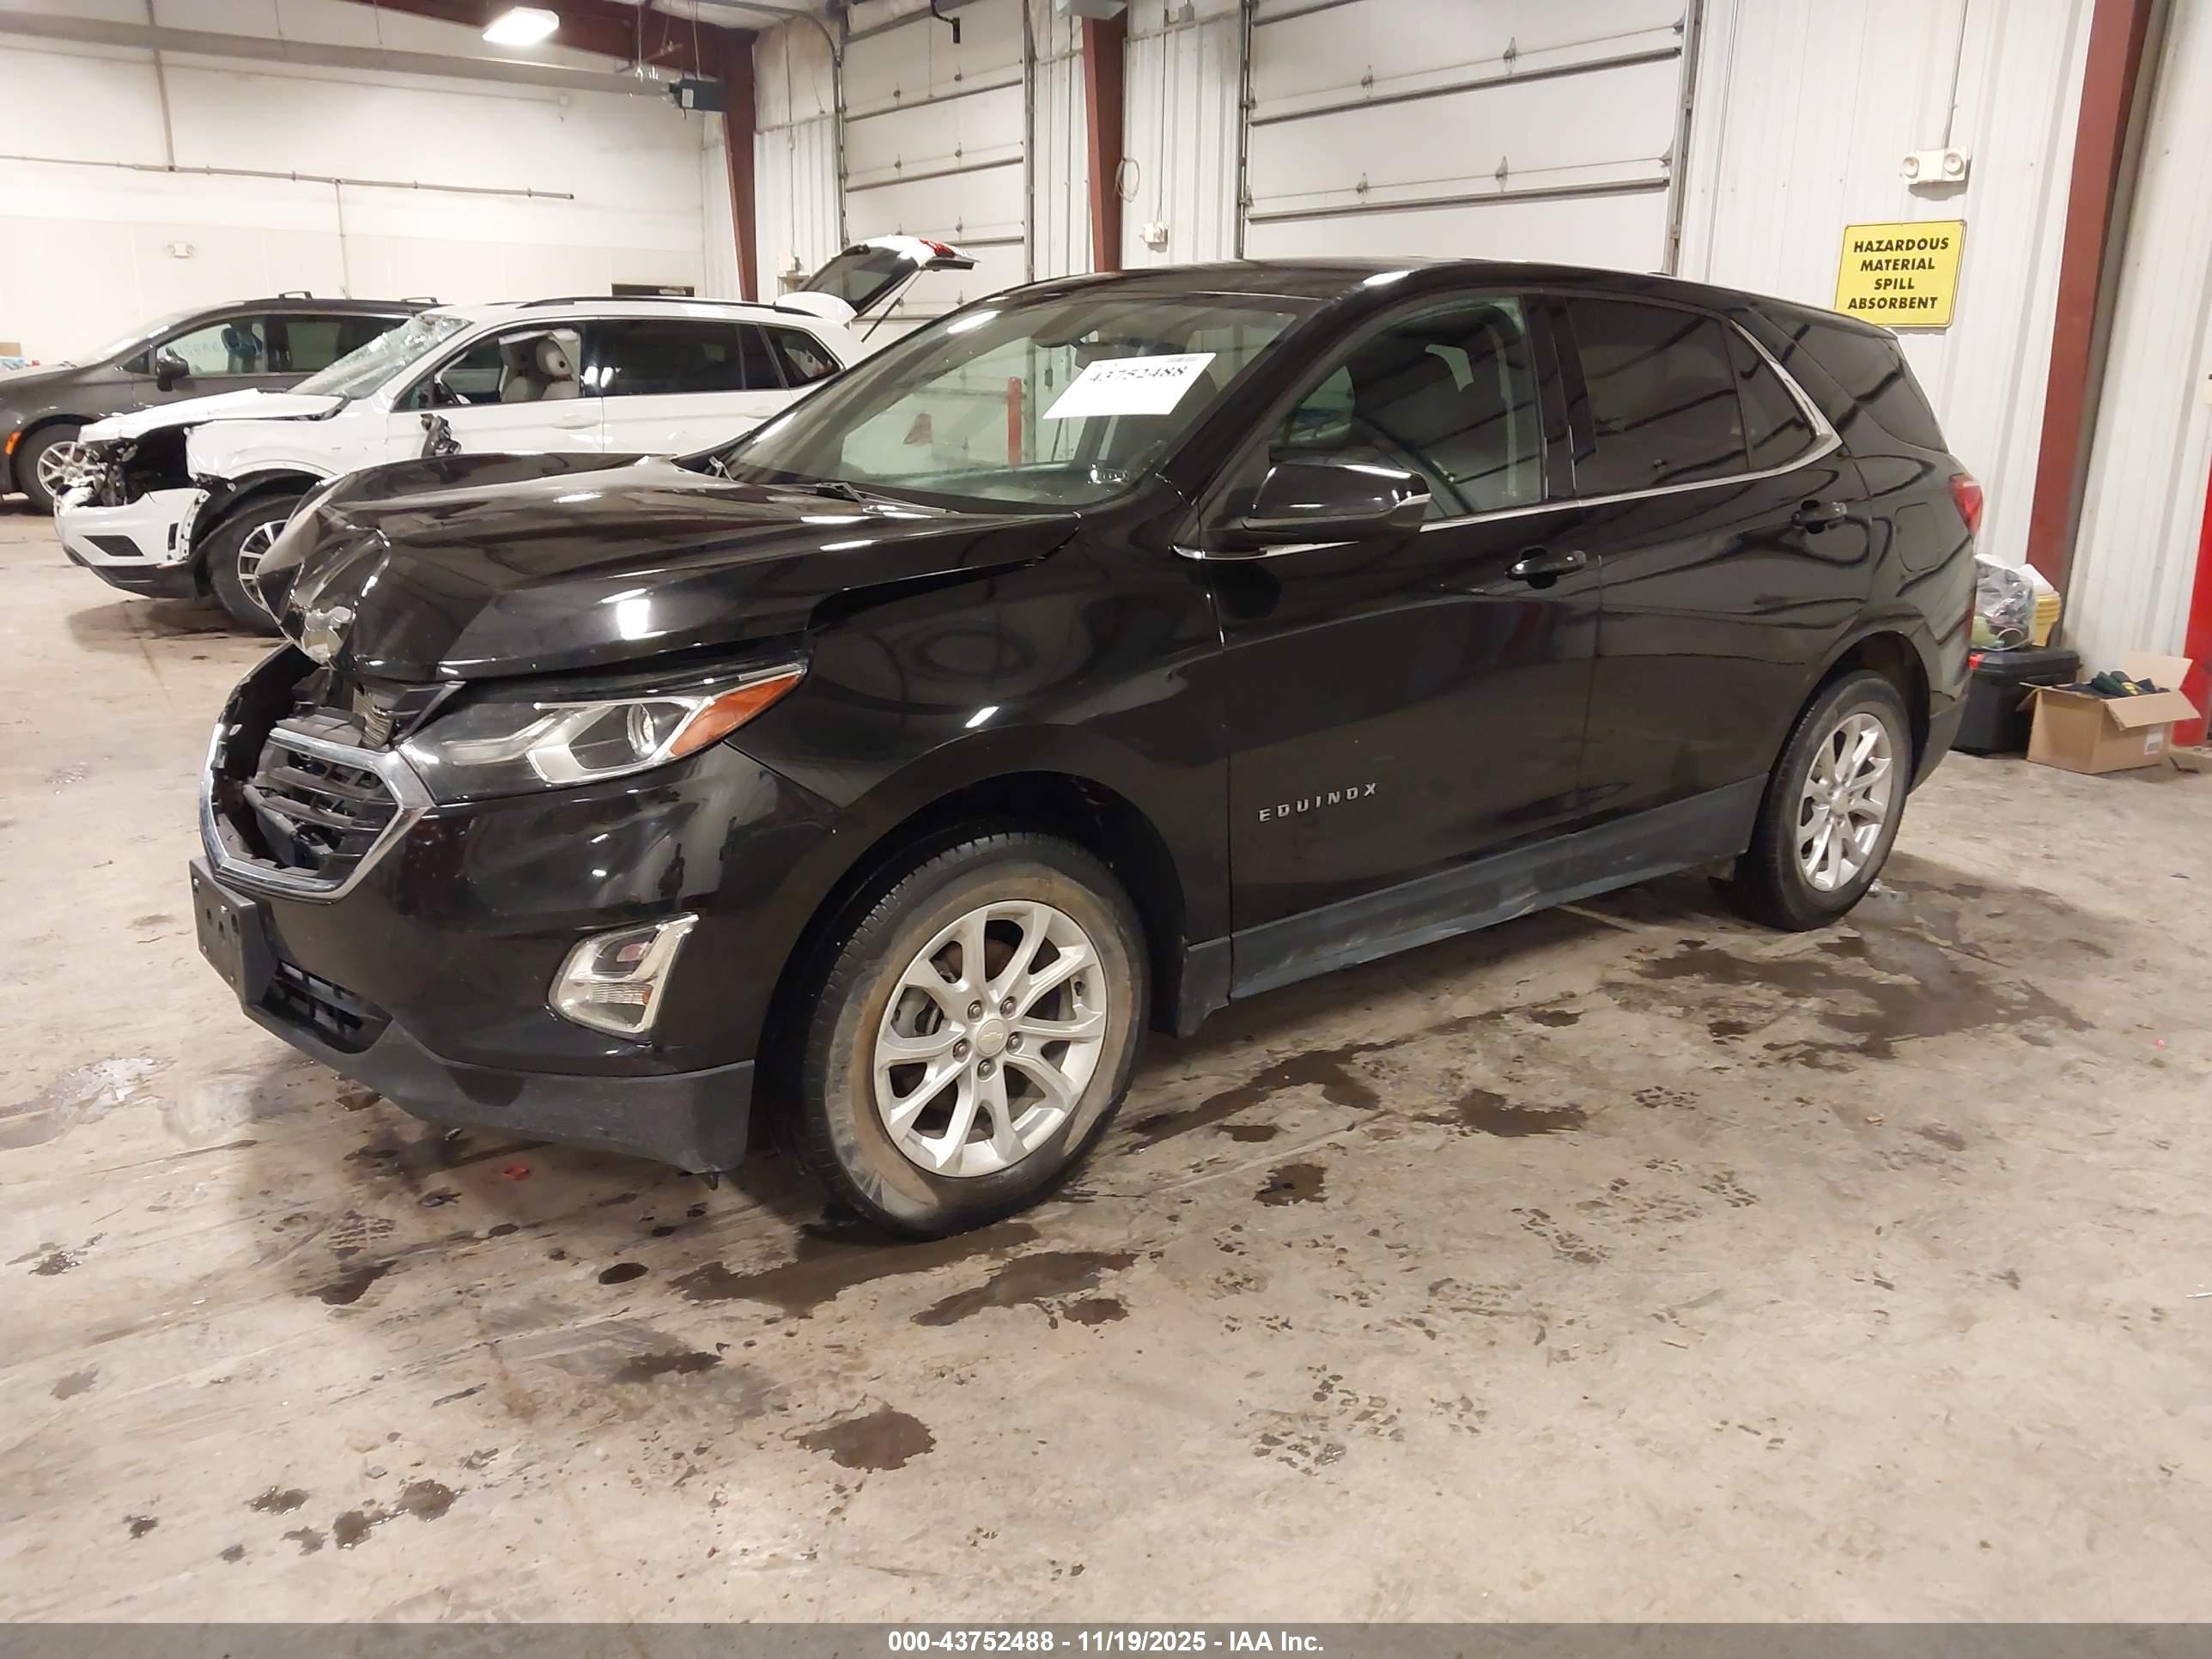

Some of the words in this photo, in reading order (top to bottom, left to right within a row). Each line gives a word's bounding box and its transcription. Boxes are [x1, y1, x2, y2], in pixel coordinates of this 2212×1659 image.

[1853, 237, 1949, 253] HAZARDOUS
[1860, 257, 1936, 271] MATERIAL
[1874, 277, 1915, 290] SPILL
[1847, 296, 1938, 310] ABSORBENT
[1258, 782, 1377, 823] EQUINOX
